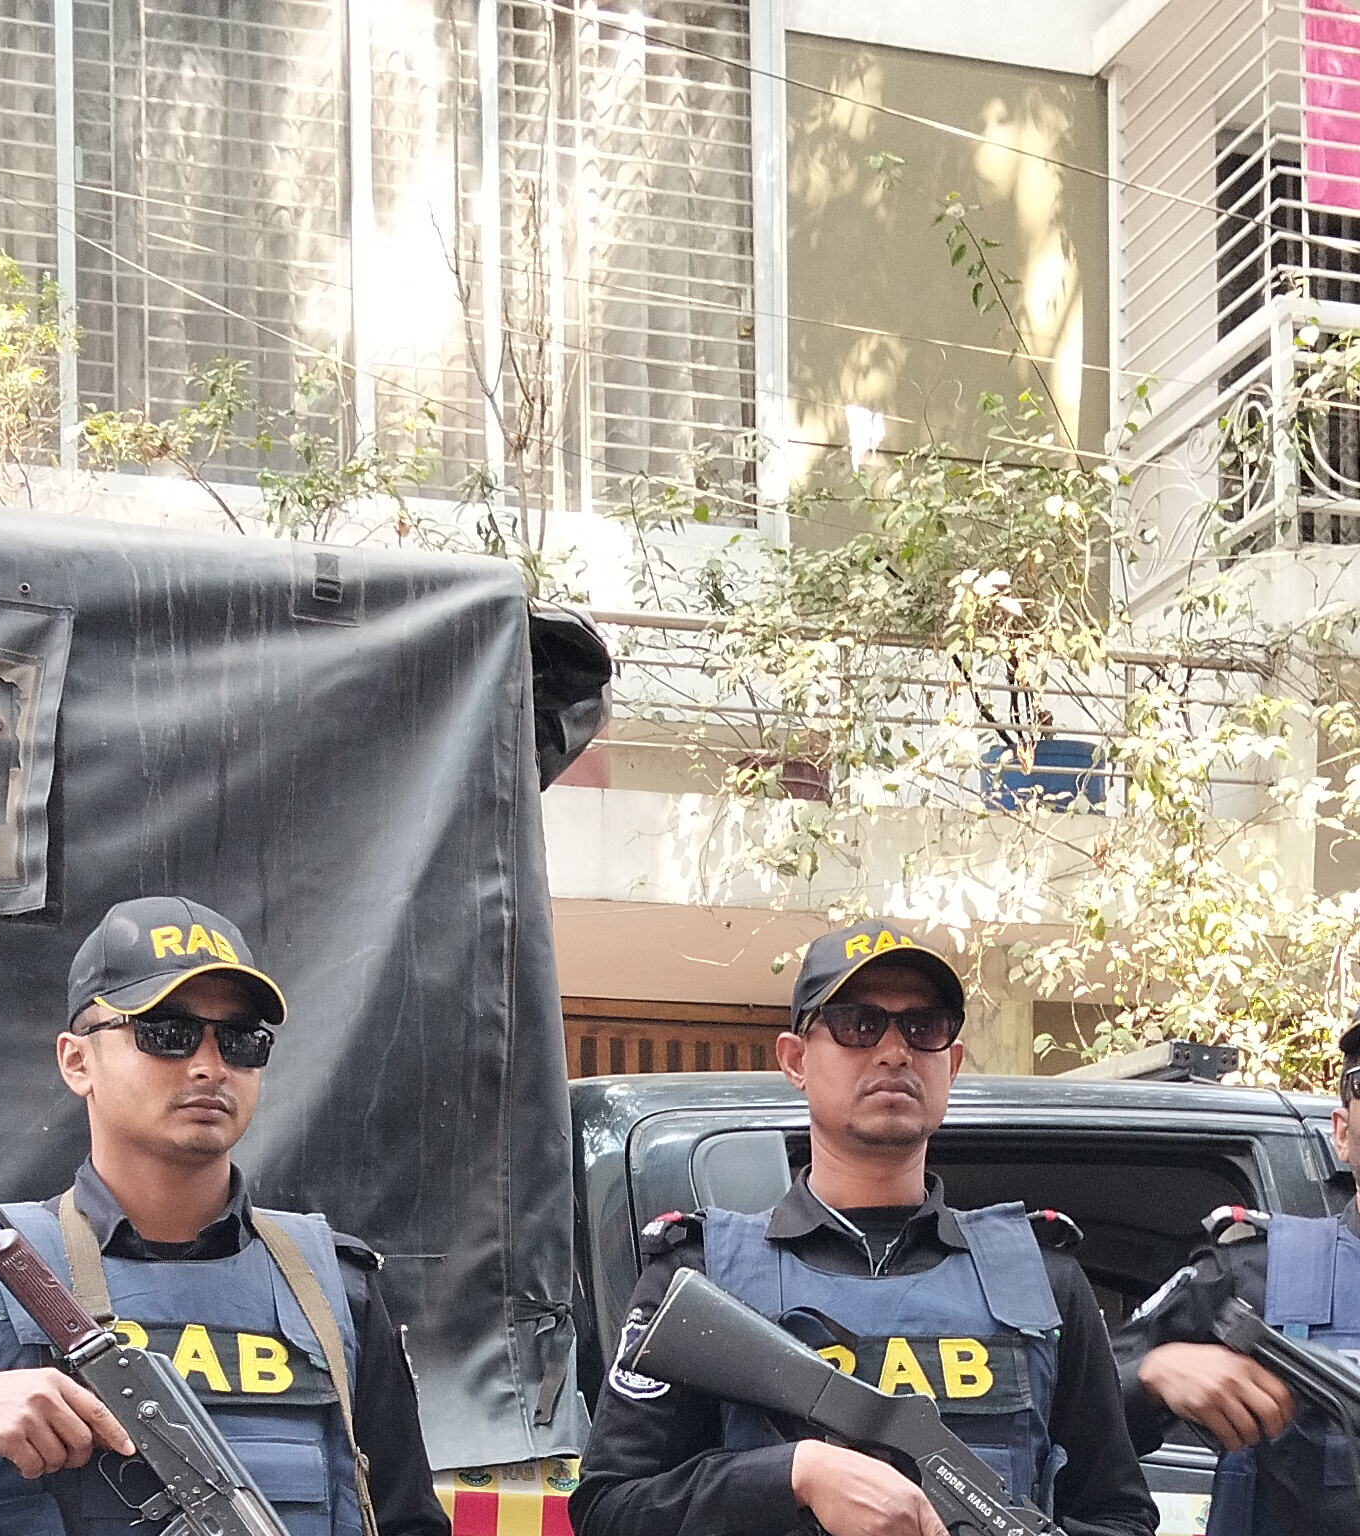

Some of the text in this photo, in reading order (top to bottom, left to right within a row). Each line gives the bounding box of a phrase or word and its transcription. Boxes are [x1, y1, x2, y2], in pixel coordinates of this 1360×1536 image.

[151, 923, 239, 964] RAB
[845, 929, 914, 960] RA
[936, 1465, 967, 1495] MODEL
[966, 1492, 994, 1517] NARG
